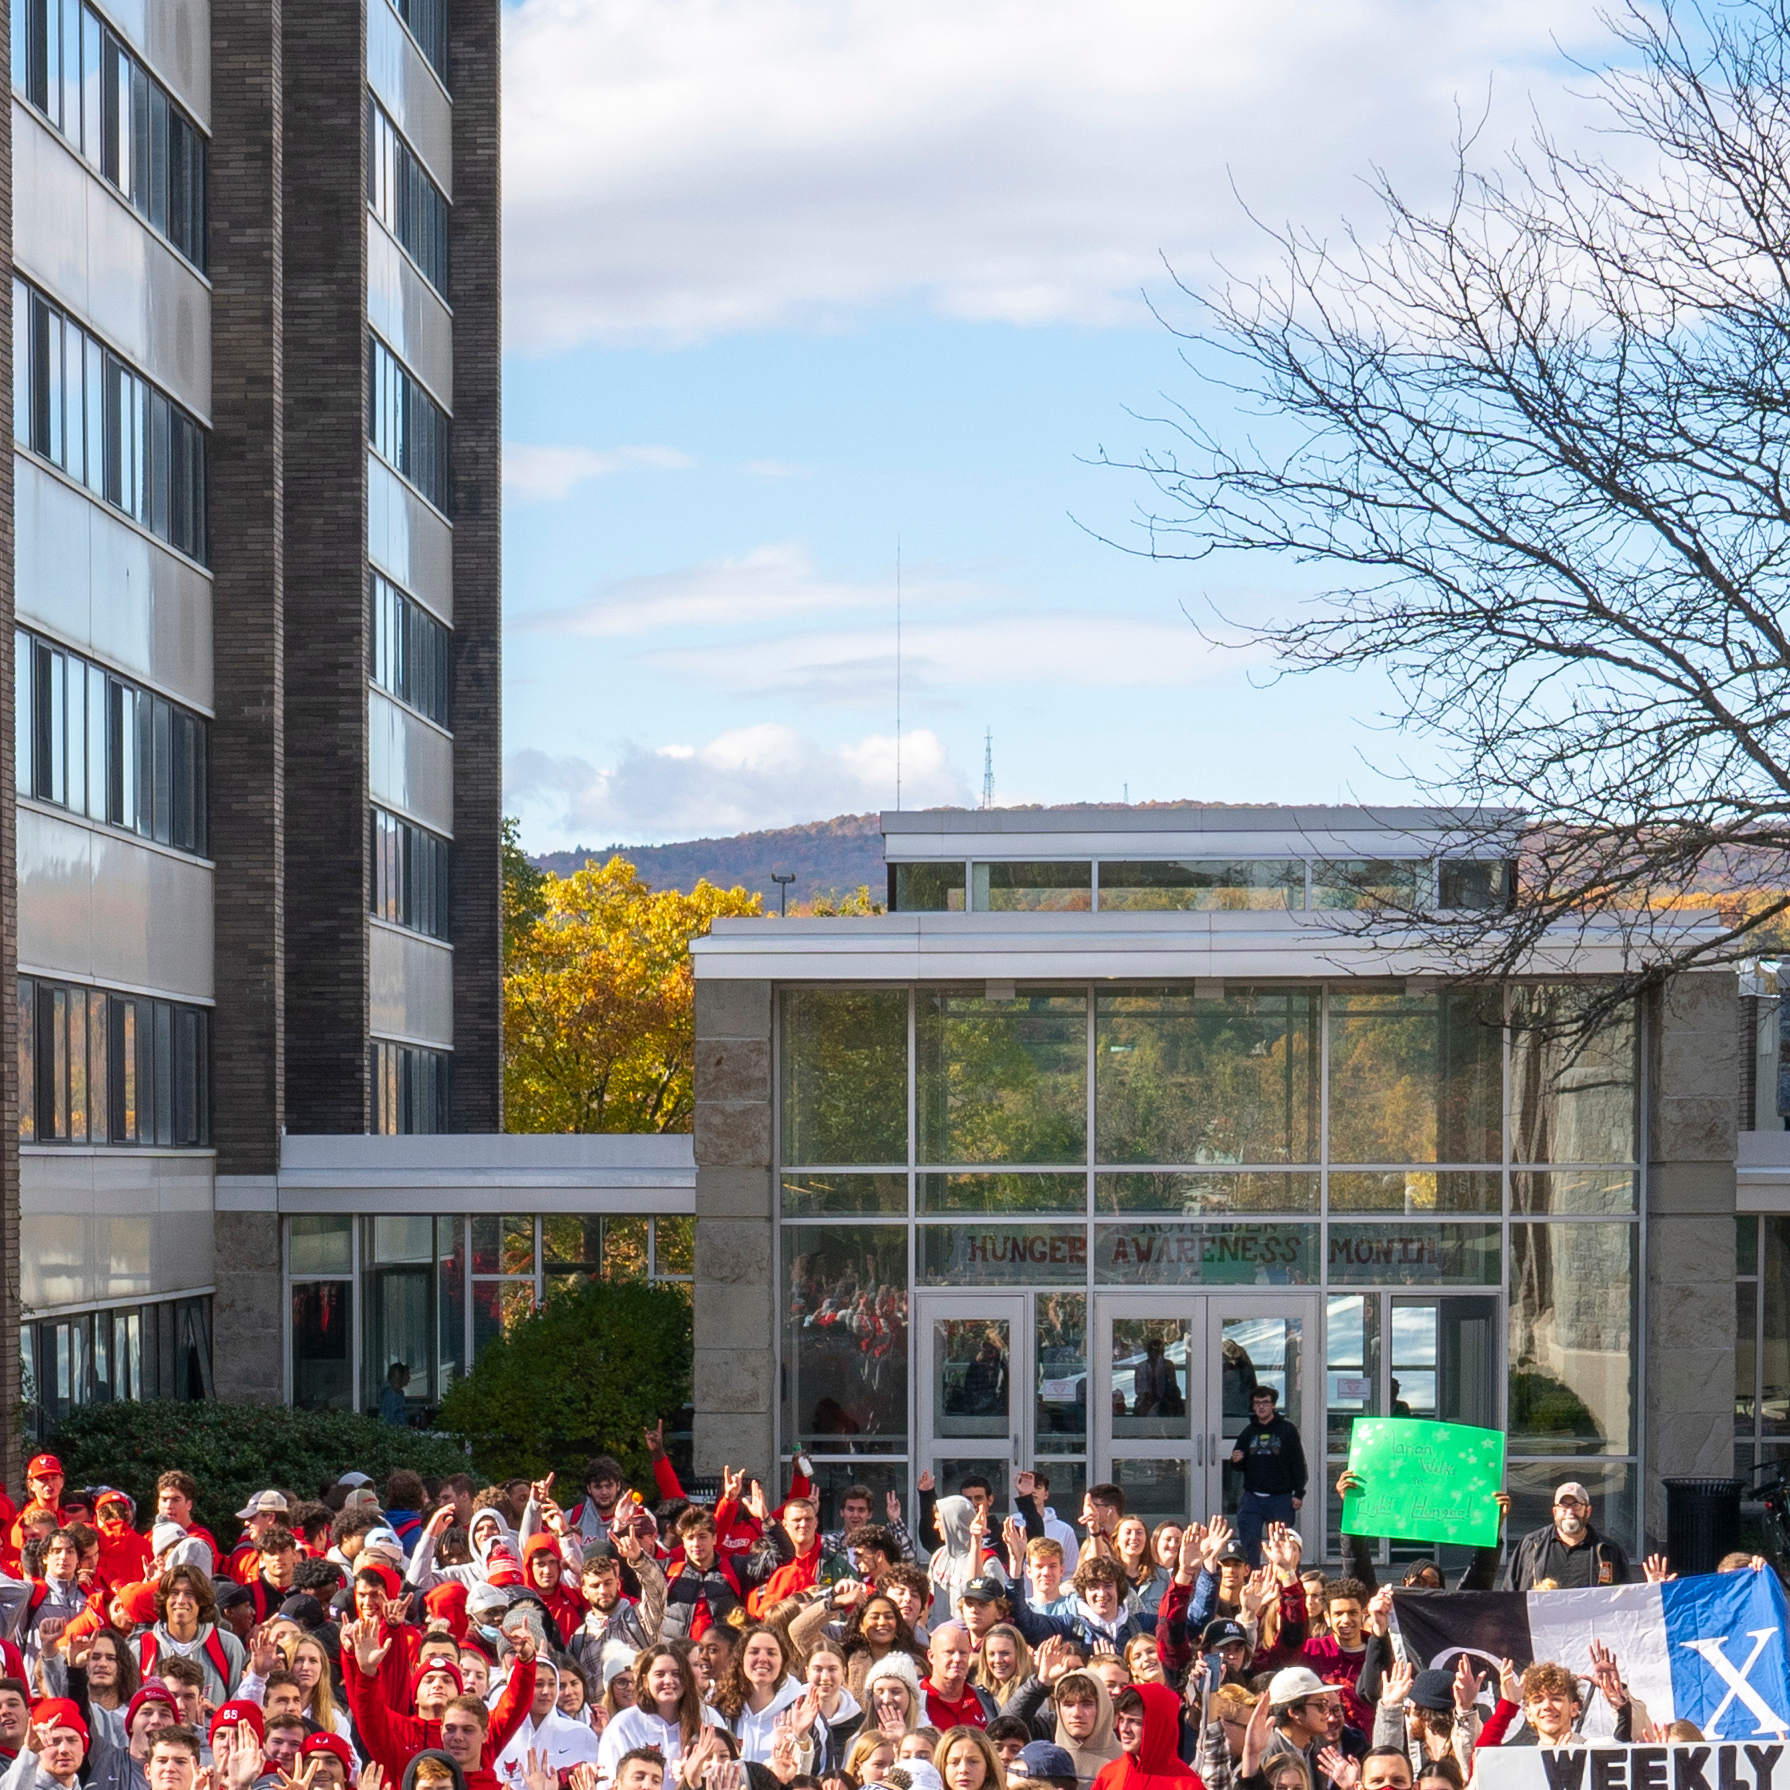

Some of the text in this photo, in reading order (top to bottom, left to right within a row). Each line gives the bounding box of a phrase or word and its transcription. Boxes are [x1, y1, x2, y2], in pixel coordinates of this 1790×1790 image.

[967, 1235, 1438, 1264] HUNGER AWARENESS MONTH
